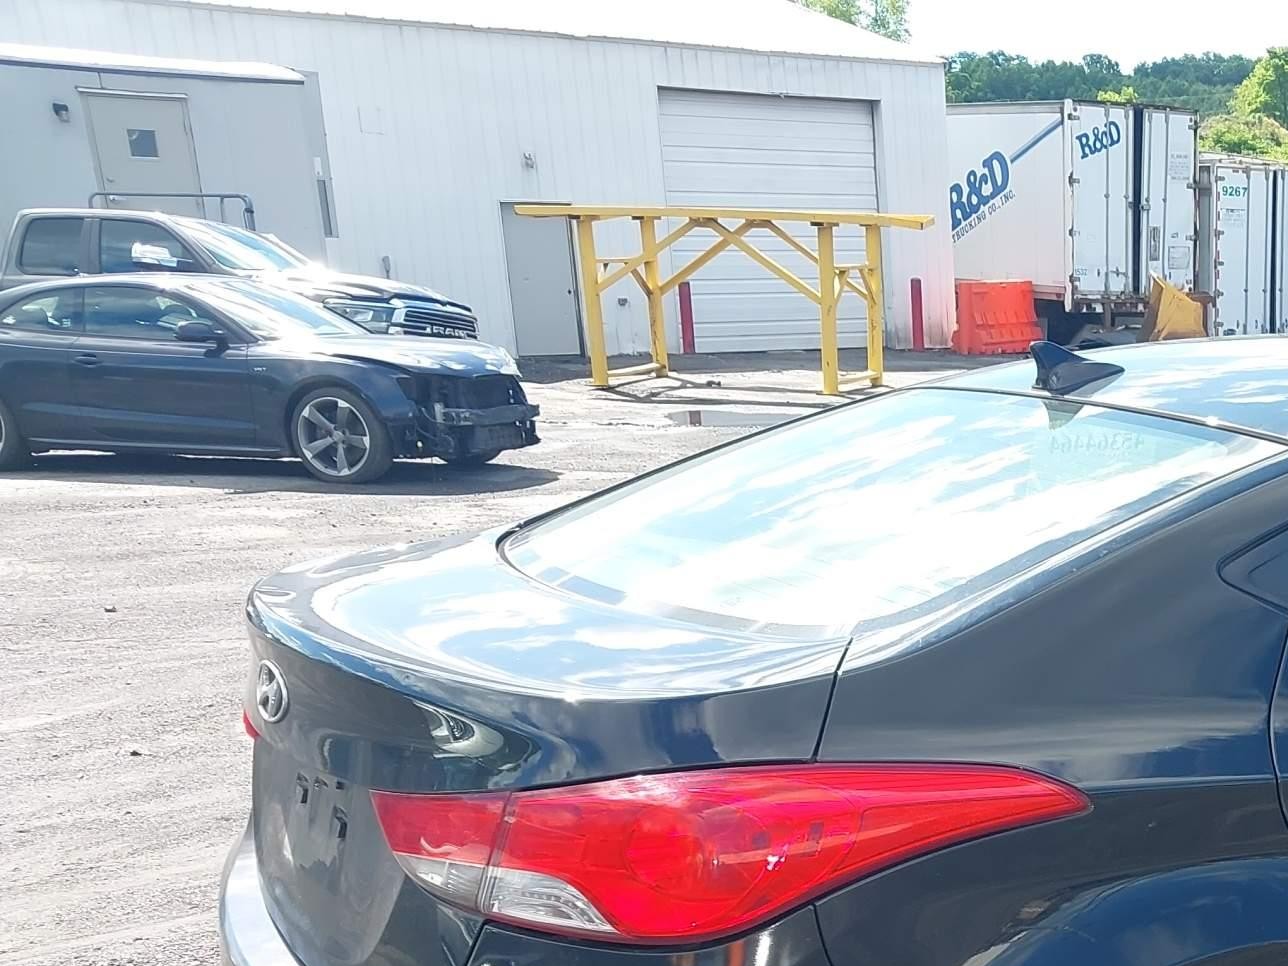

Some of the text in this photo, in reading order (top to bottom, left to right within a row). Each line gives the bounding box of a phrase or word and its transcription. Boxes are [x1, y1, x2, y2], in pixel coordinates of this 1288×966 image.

[1075, 120, 1121, 160] R&D
[949, 150, 1010, 232] R&D
[1222, 185, 1248, 197] 9267
[952, 210, 987, 243] TRUCKING
